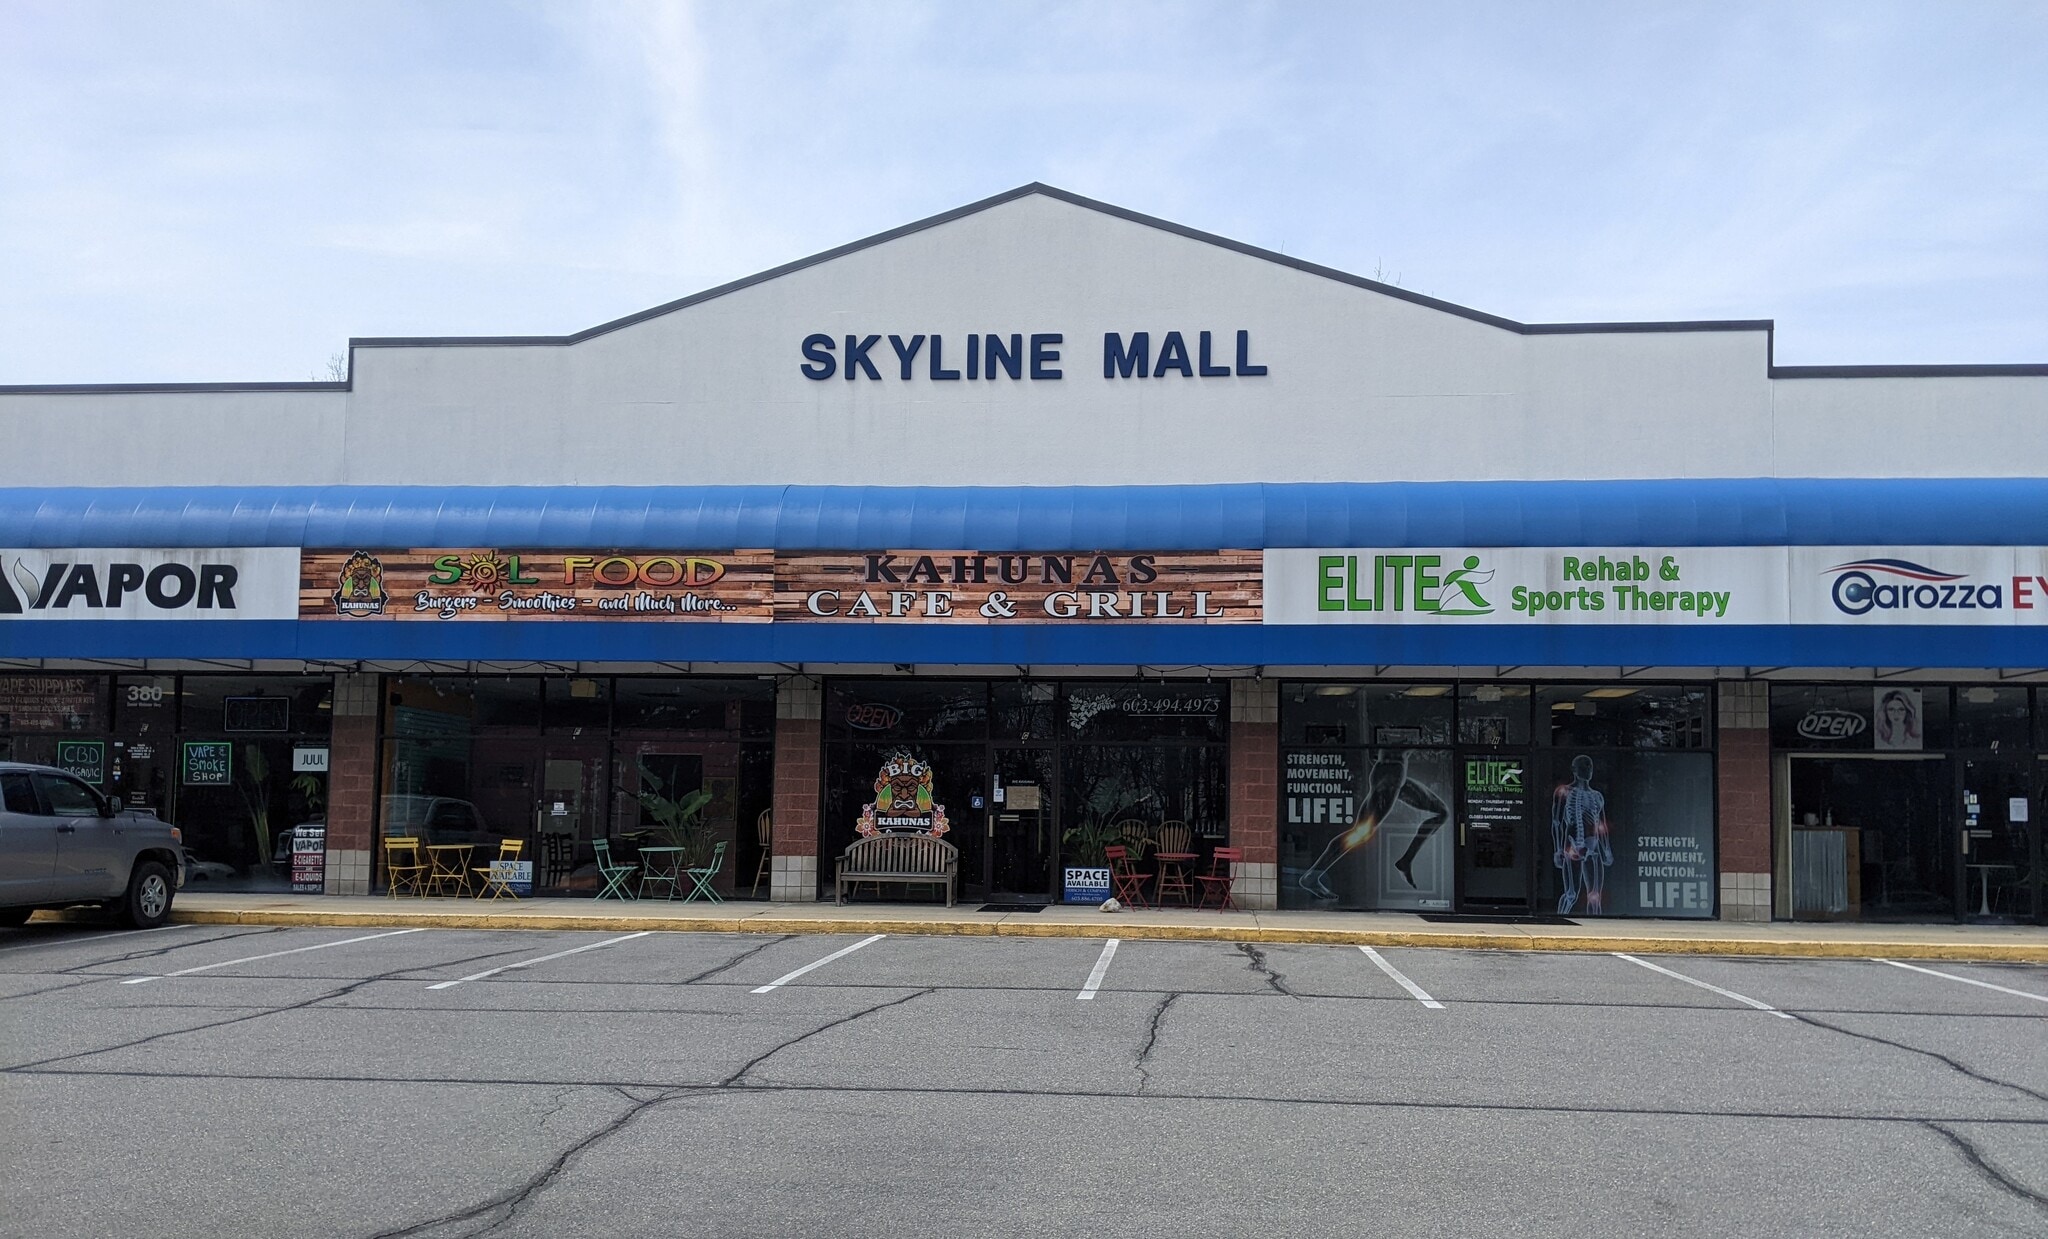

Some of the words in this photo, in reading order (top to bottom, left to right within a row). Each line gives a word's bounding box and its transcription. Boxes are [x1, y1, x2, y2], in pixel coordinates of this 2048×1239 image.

[800, 332, 1063, 381] SKYLINE
[1103, 330, 1267, 379] MALL
[564, 556, 724, 587] FOOD
[865, 554, 1158, 584] KAHUNAS
[1563, 555, 1650, 581] Rehab
[1658, 556, 1680, 581] &
[16, 558, 238, 609] VAPOR
[1318, 555, 1441, 611] ELITE
[1511, 585, 1604, 617] Sports
[1612, 586, 1731, 617] Therapy
[1832, 571, 2002, 615] Carozza
[413, 590, 477, 618] Burgers
[498, 590, 576, 612] Smoothies
[599, 590, 628, 612] and
[633, 592, 675, 615] Much
[680, 592, 737, 612] More...
[807, 589, 954, 617] CAFE
[978, 591, 1019, 617] &
[1043, 590, 1225, 618] GRILL
[29, 678, 85, 694] SUPPLIES
[127, 686, 162, 701] 380
[847, 704, 897, 729] OPEN
[1802, 714, 1859, 737] OPEN
[64, 746, 99, 763] CBD
[189, 746, 215, 758] VAPE
[301, 754, 324, 766] JUUL
[1287, 754, 1346, 767] STRENGTH,
[189, 759, 226, 772] SMOKE
[887, 762, 924, 777] BIG
[1467, 761, 1507, 785] ELITE
[193, 772, 223, 782] SHOP
[1287, 768, 1352, 781] MOVEMENT,
[1287, 783, 1353, 794] FUNCTION...
[1288, 797, 1354, 824] LIFE!
[878, 817, 930, 826] KAHUNAS
[1638, 836, 1699, 850] STRENGTH,
[1638, 851, 1706, 865] MOVEMENT,
[1067, 870, 1108, 880] SPACE
[1638, 866, 1707, 878] FUNCTION...
[1640, 881, 1708, 909] LIFE!
